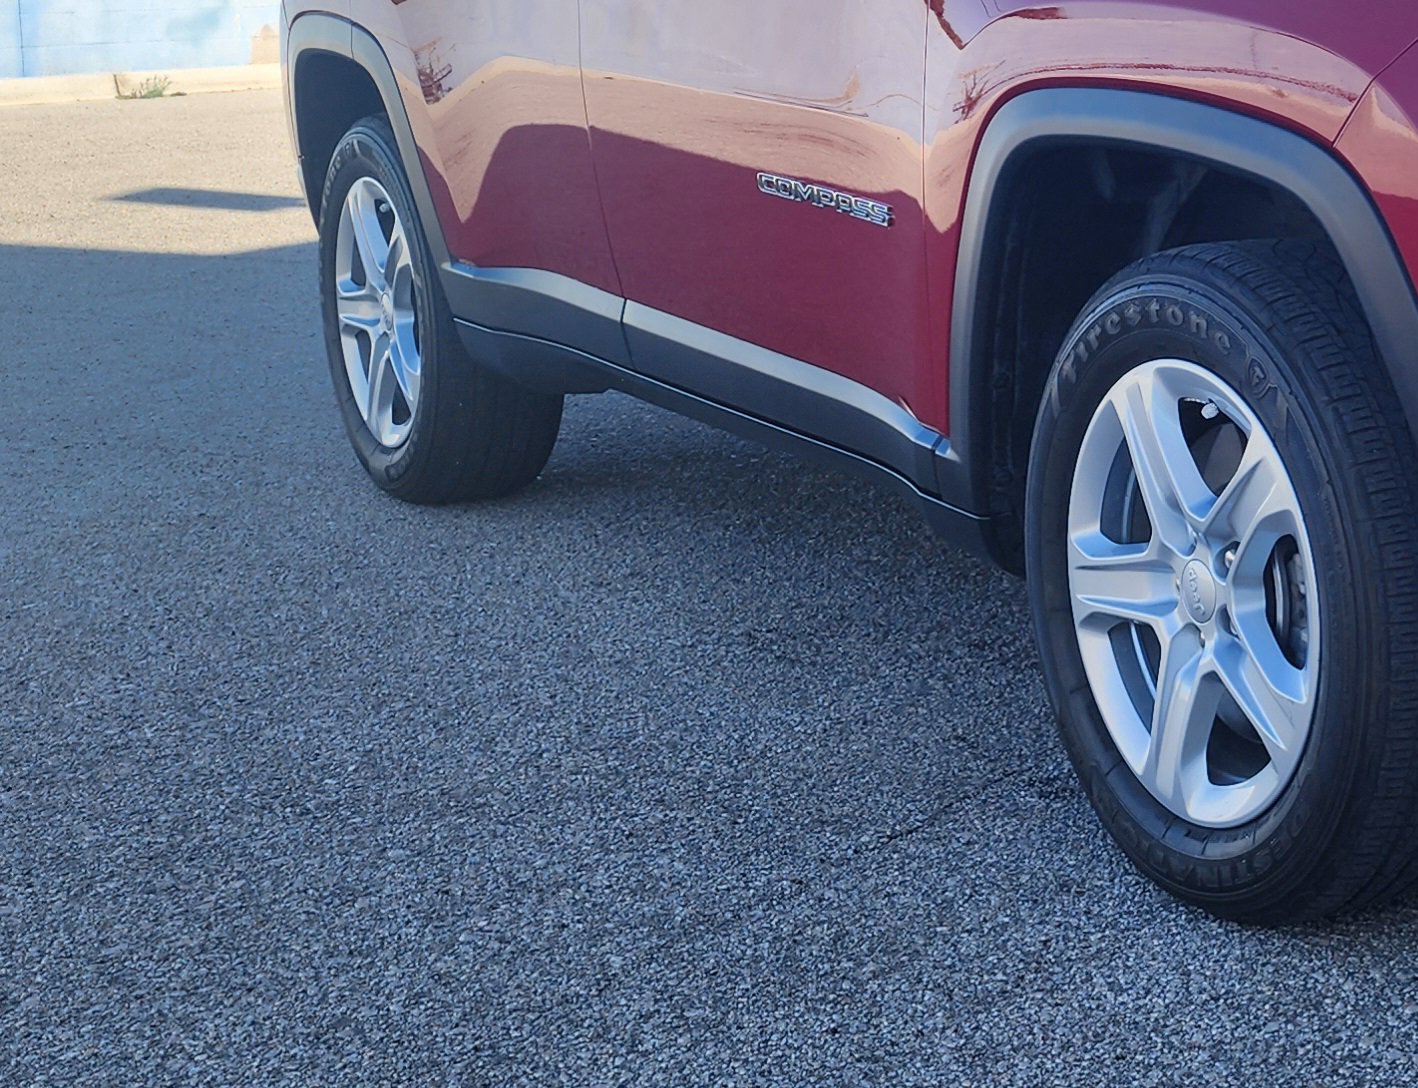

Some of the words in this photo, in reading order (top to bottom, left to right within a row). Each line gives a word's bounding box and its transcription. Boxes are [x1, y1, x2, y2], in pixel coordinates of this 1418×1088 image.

[756, 172, 895, 228] COMPASS
[1056, 297, 1232, 385] Firestone
[1188, 567, 1206, 616] Jeep
